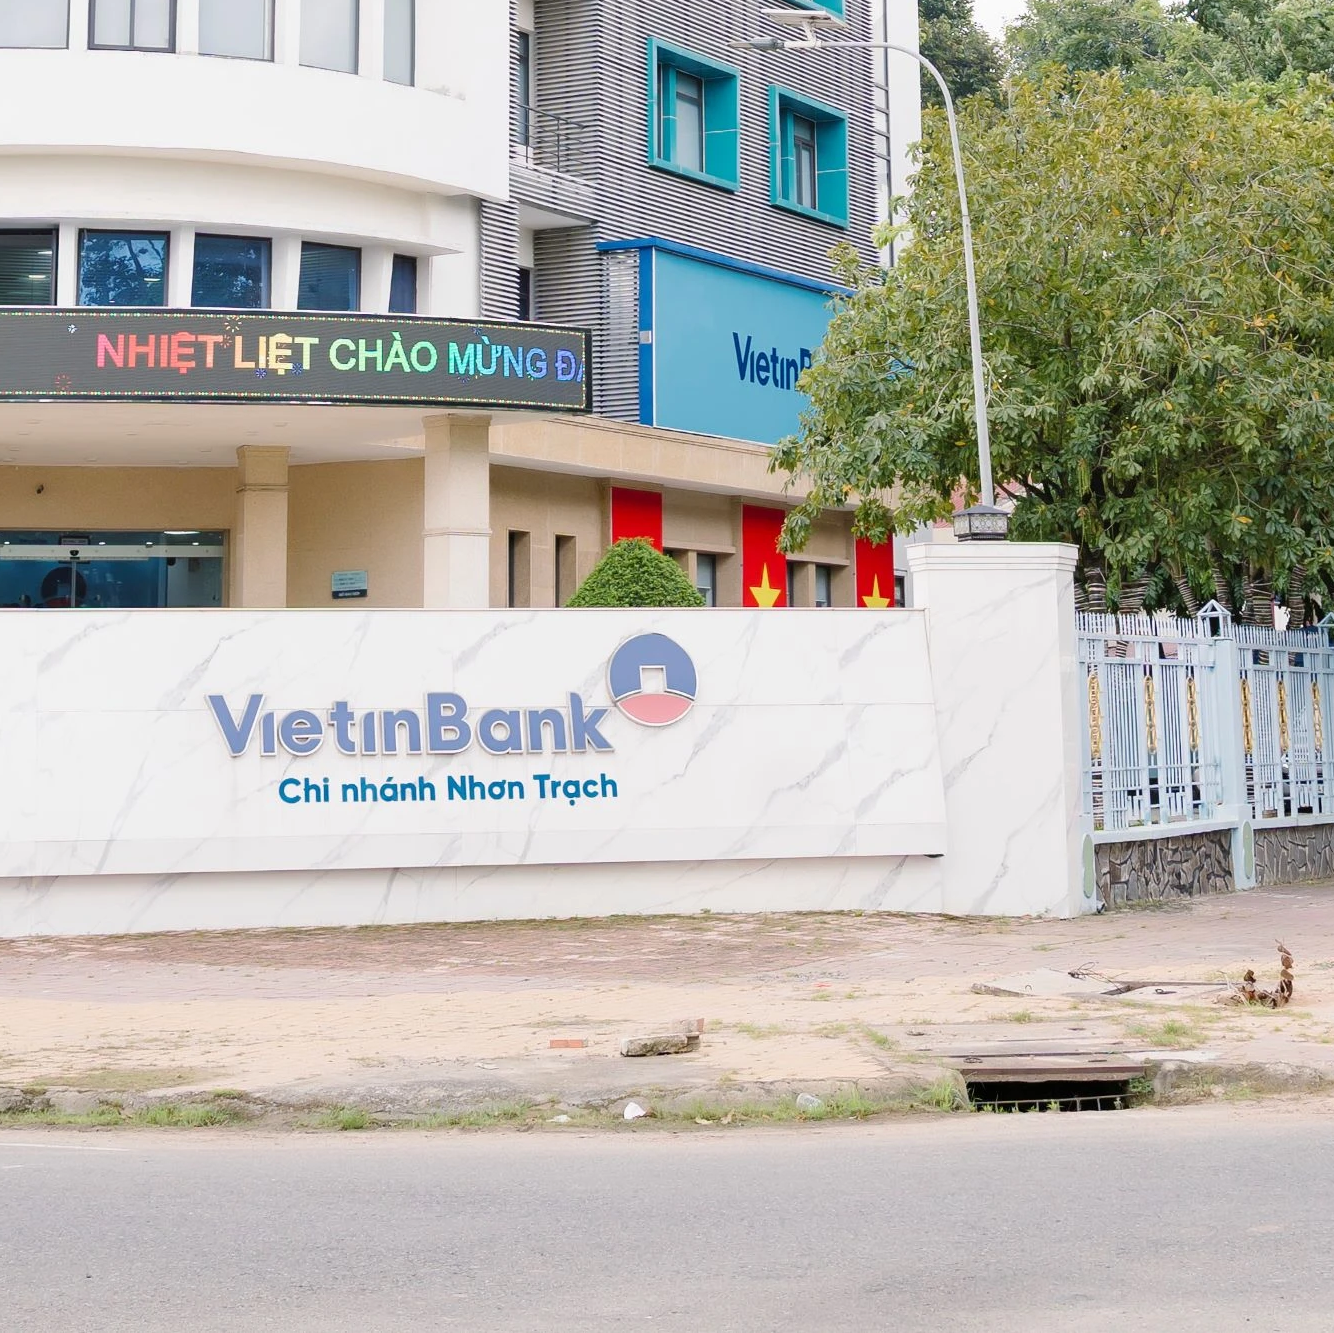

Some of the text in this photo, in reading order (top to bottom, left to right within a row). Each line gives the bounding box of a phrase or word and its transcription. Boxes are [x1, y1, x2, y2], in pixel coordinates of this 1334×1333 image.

[96, 331, 224, 375] NHIỆT
[233, 332, 320, 376] LIỆT
[328, 331, 439, 373] CHÀO
[447, 335, 549, 380] MỪNG
[204, 690, 616, 758] VietinBank
[278, 772, 619, 806] Chi nhánh Nhơn Trạch
